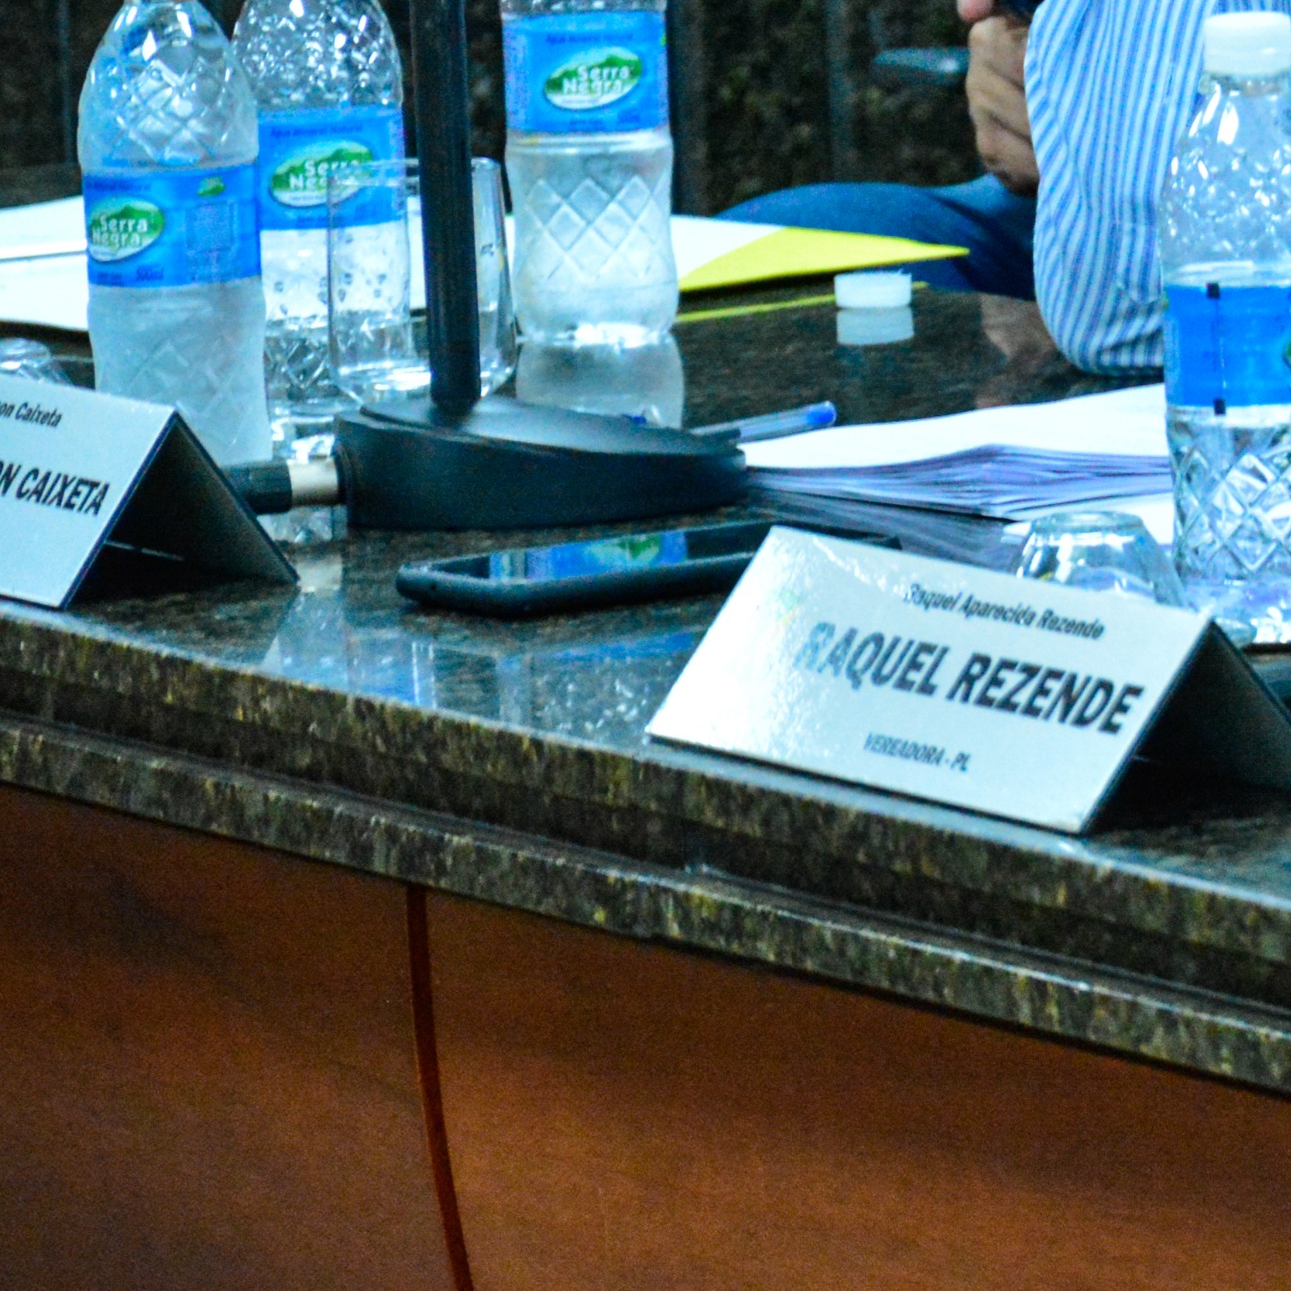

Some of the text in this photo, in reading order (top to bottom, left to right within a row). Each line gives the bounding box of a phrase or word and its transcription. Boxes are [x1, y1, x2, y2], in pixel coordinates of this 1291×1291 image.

[577, 65, 631, 80] Serra
[562, 78, 623, 98] Negra
[99, 214, 148, 233] Serra
[92, 228, 141, 251] Negra
[15, 401, 63, 428] Caixeta
[16, 468, 110, 516] CAIXETA
[903, 584, 1105, 640] Raquel Aparecida Rezende
[793, 622, 1145, 735] RAQUEL REZENDE
[863, 731, 945, 766] VEREADORA
[950, 751, 970, 773] PL
